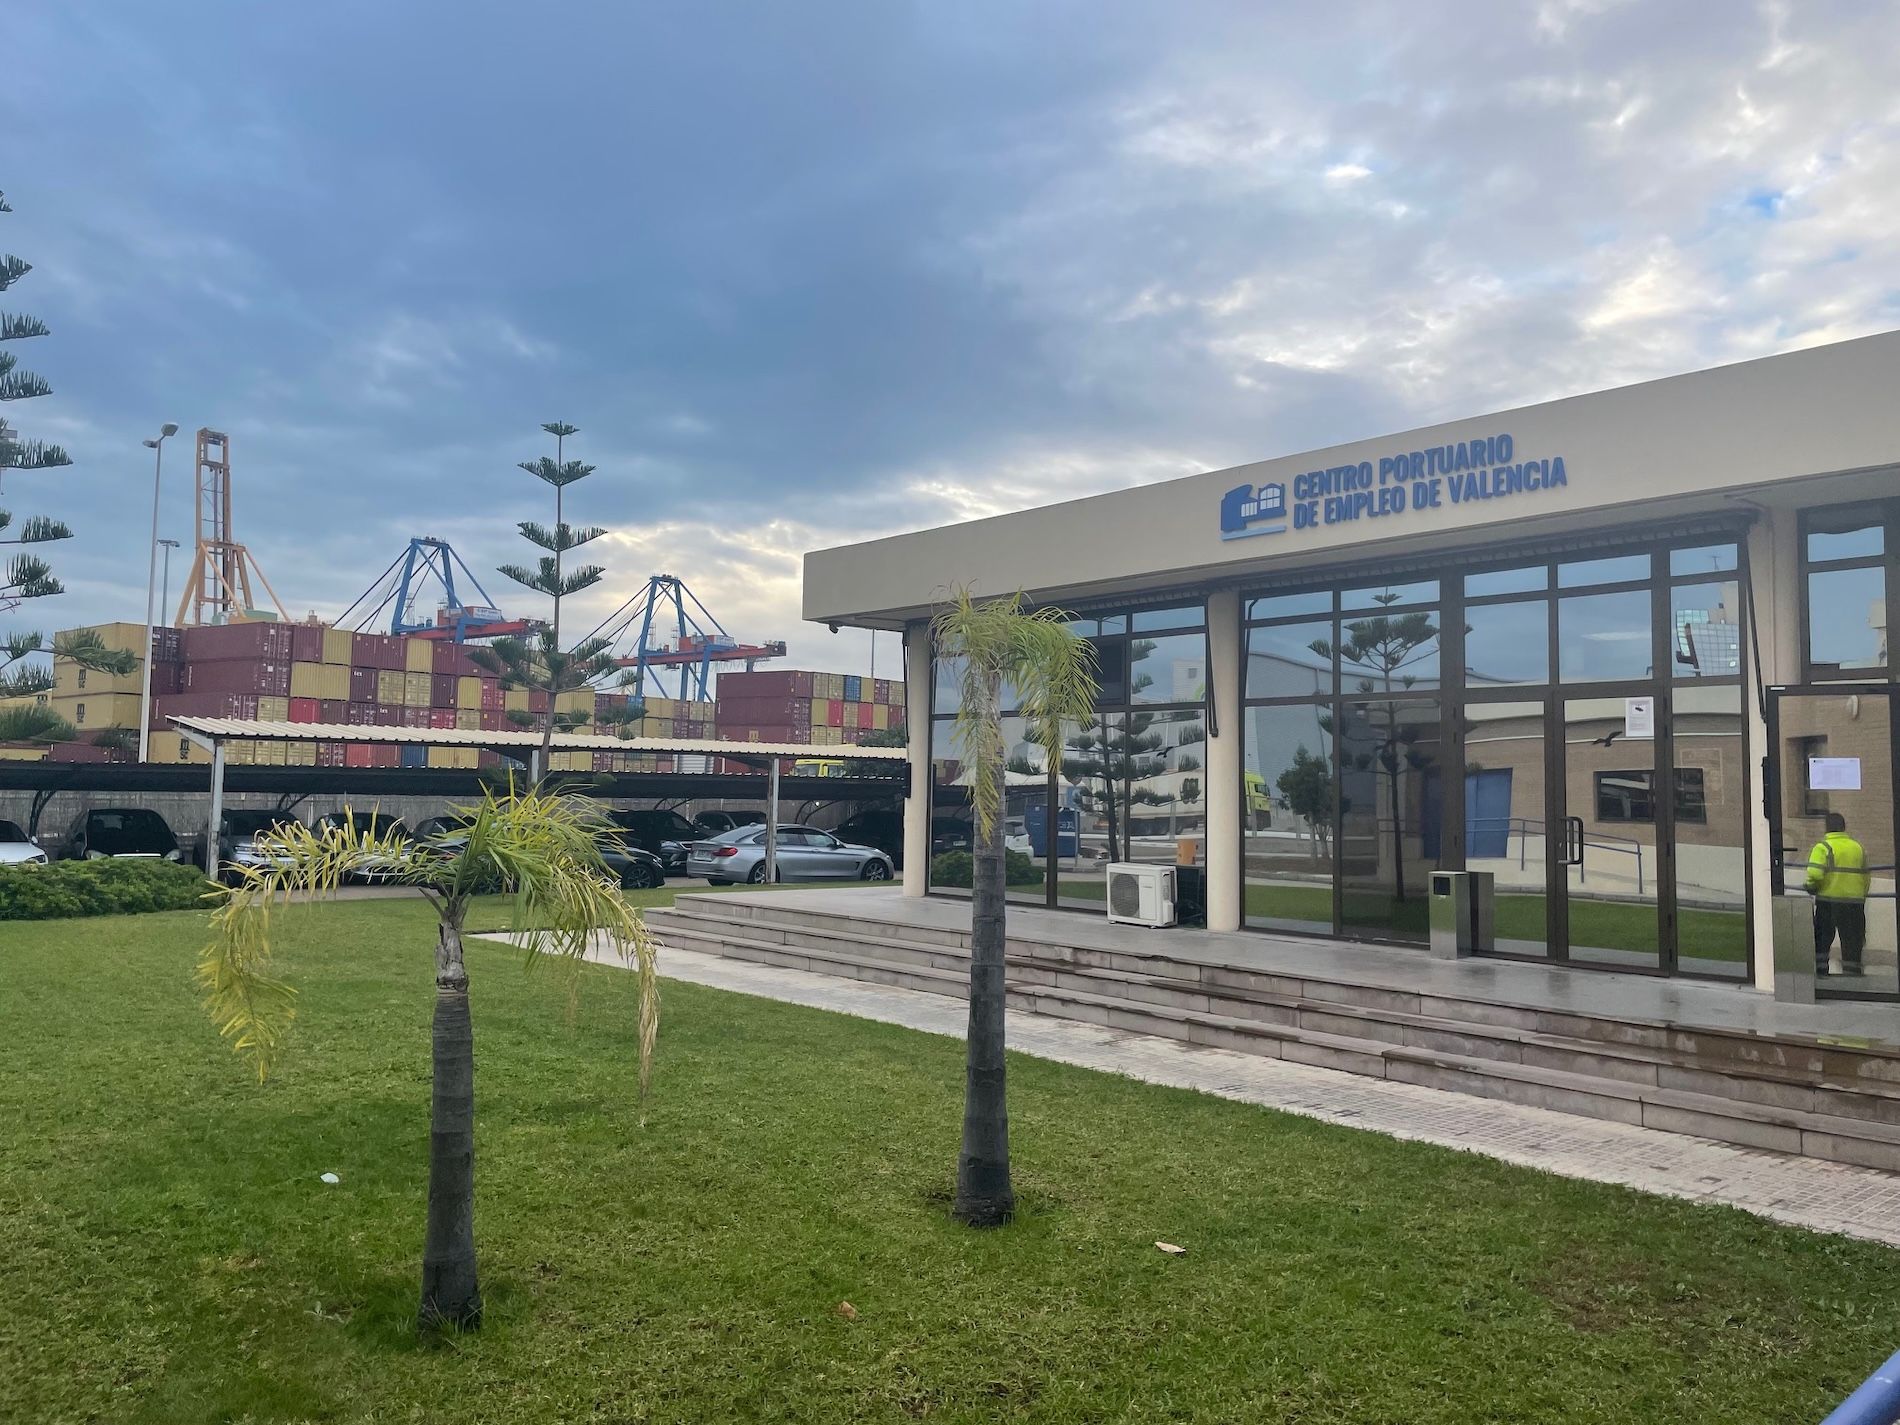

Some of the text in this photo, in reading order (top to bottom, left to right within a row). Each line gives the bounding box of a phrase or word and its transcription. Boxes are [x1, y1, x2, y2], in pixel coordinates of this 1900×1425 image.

[1293, 433, 1513, 500] CENTRO PORTUARIO
[1293, 456, 1568, 529] DE EMPLEO DE VALENCIA
